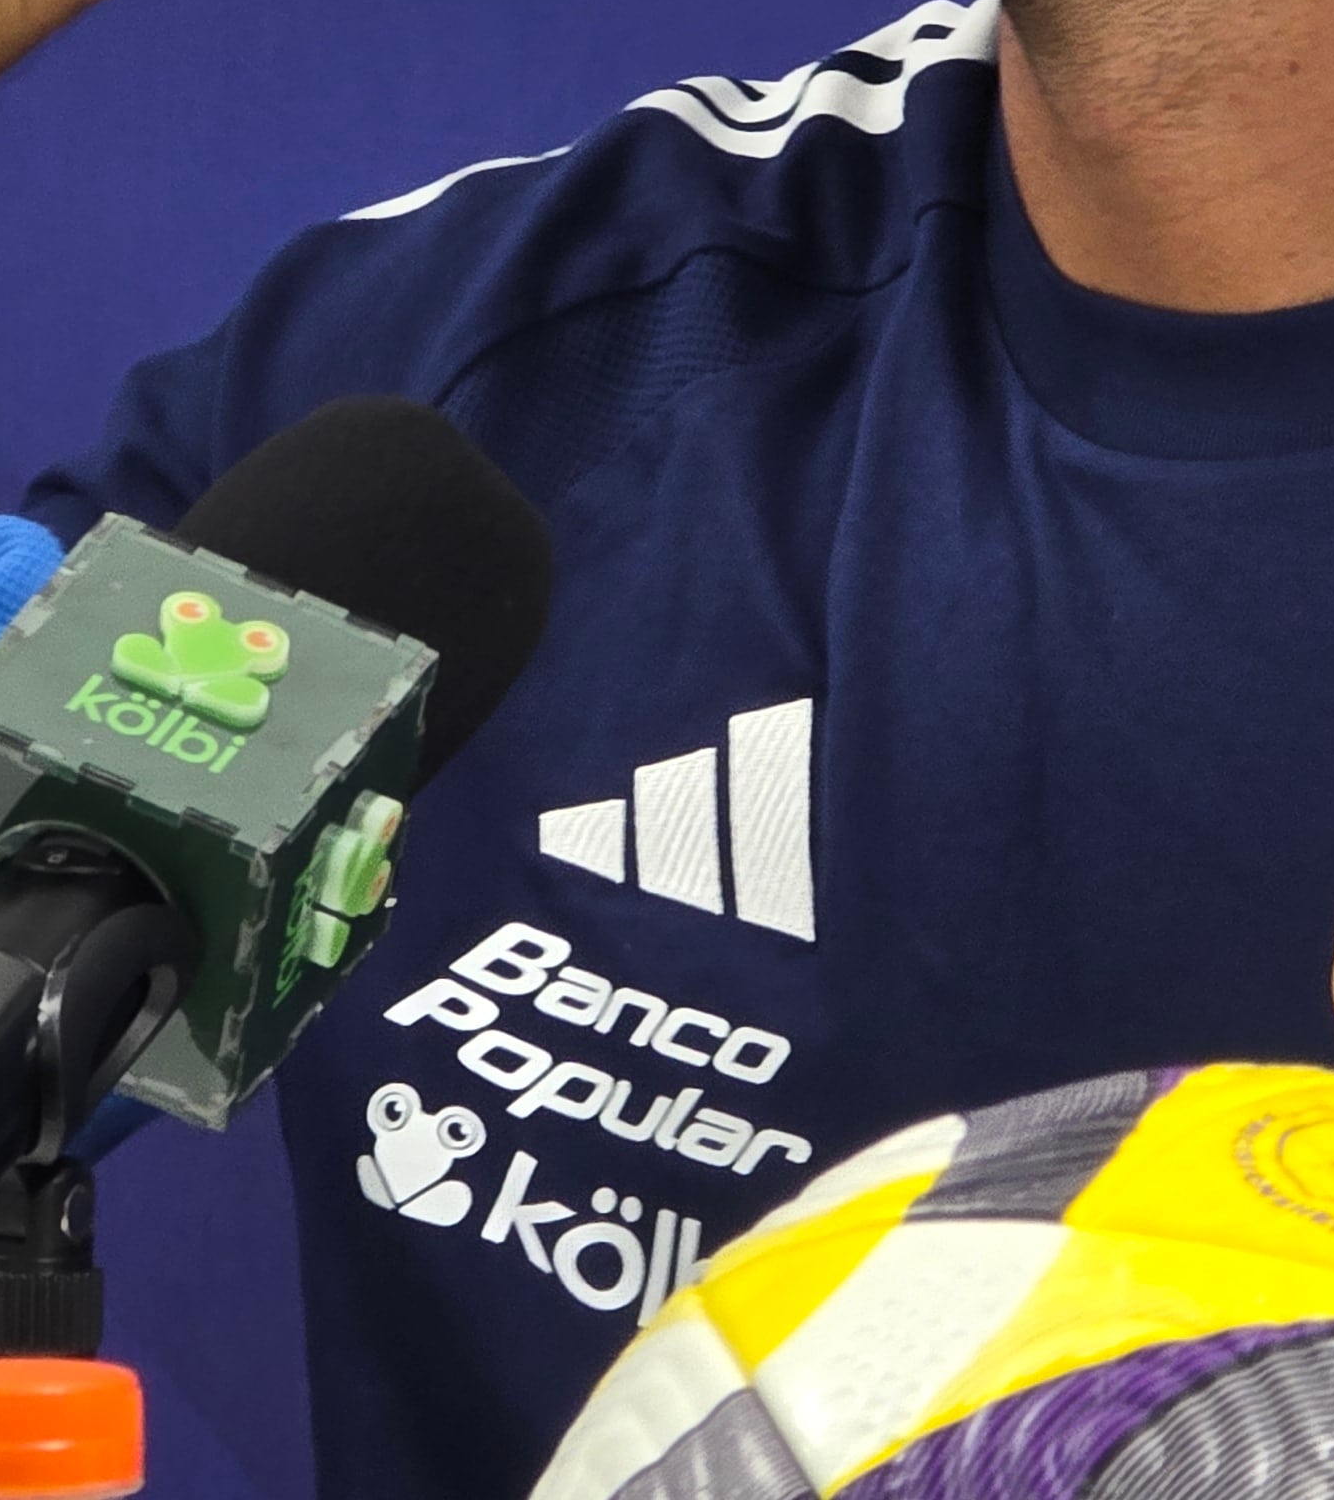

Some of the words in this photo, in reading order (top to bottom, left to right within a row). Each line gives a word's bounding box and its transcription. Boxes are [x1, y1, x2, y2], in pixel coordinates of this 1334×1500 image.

[64, 673, 248, 775] kölbi
[382, 978, 814, 1176] Popular
[448, 921, 793, 1085] Banco
